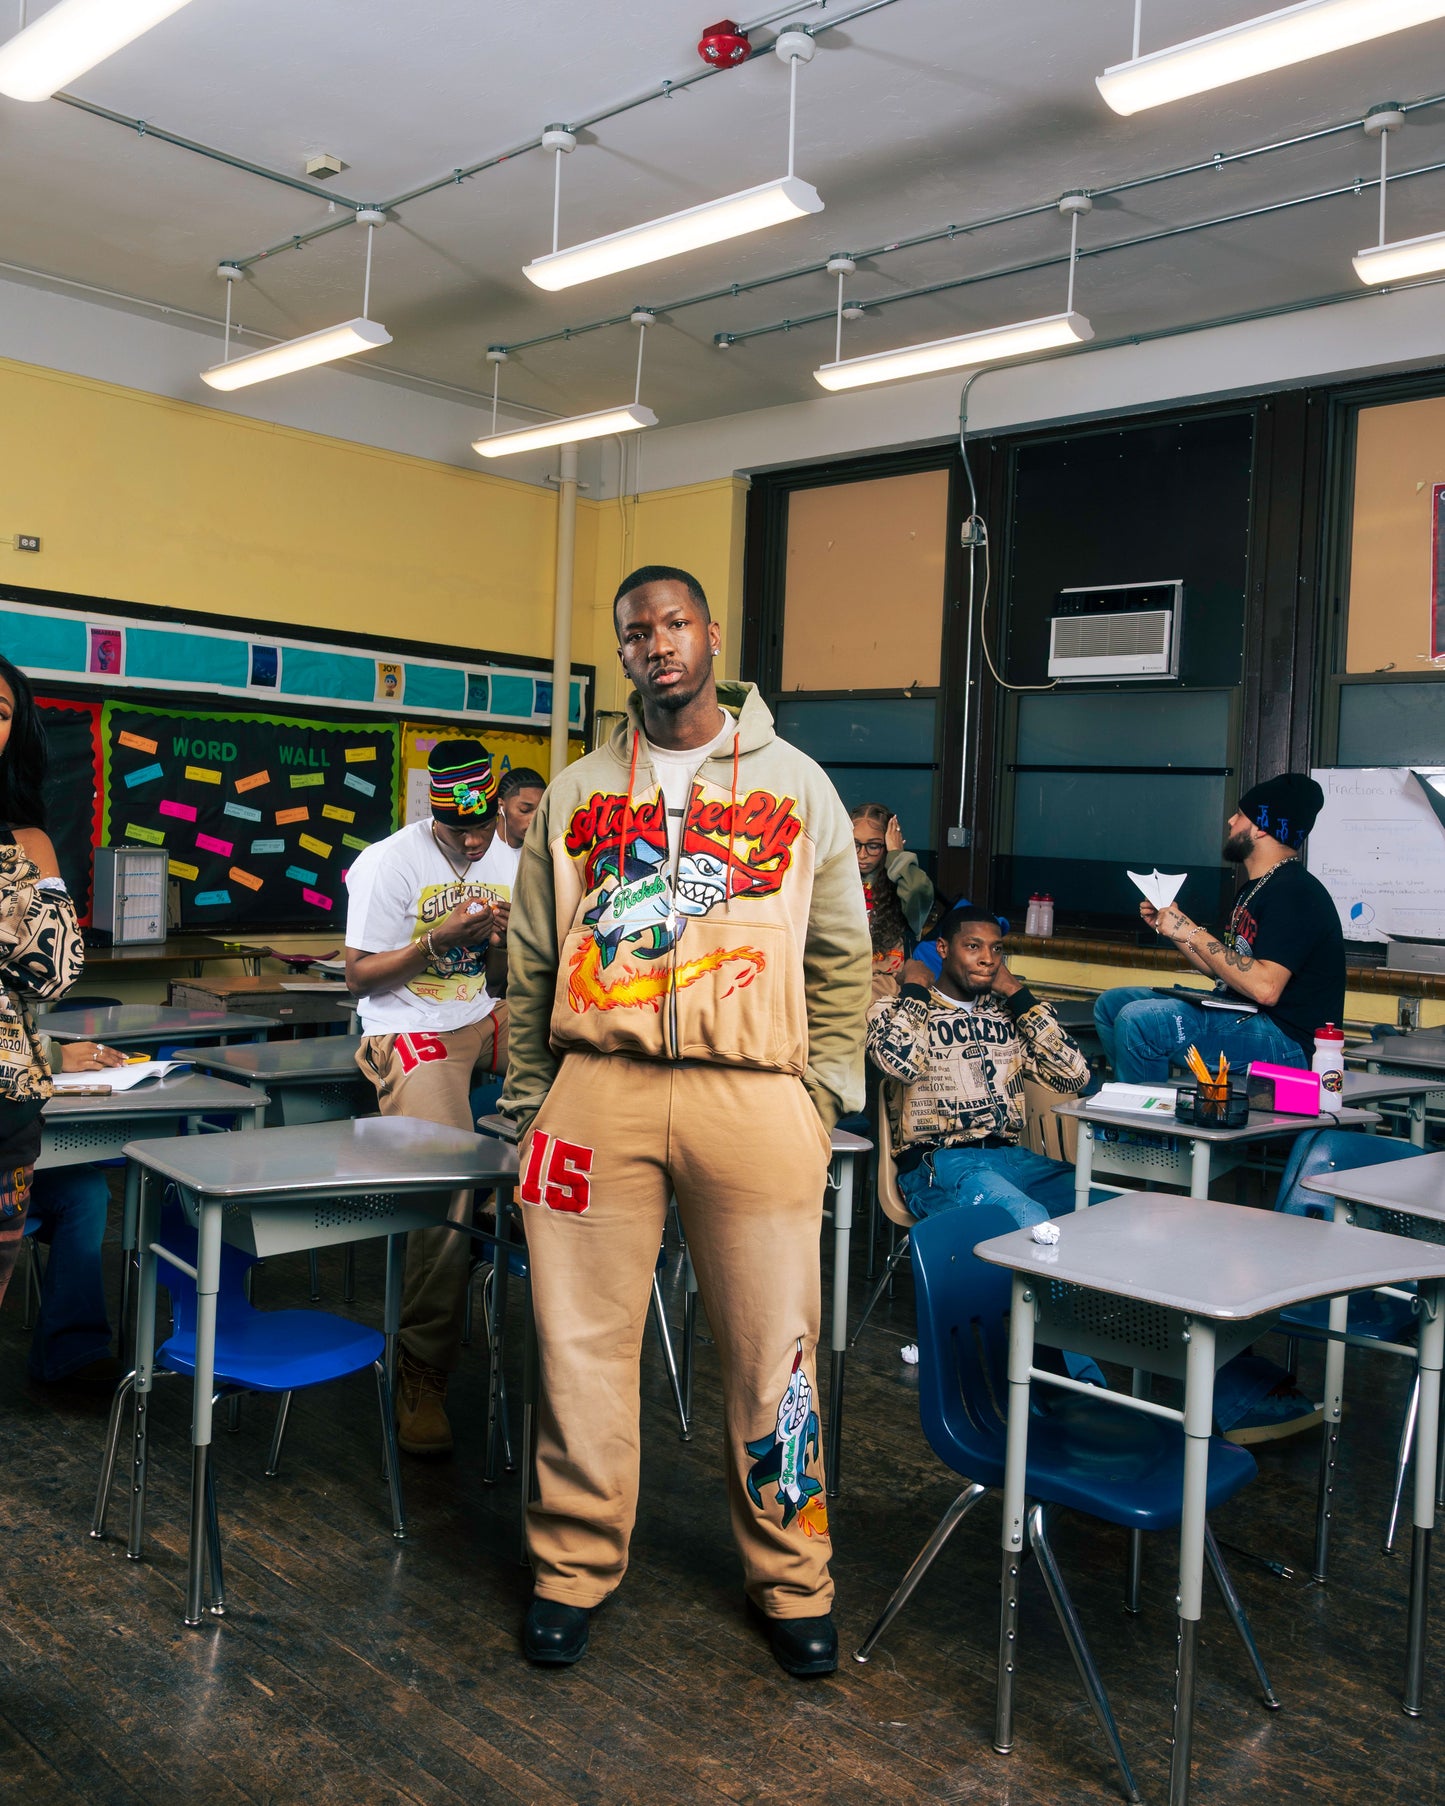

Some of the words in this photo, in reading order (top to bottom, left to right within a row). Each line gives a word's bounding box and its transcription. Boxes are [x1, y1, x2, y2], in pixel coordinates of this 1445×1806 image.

[382, 664, 398, 673] JOY
[173, 736, 238, 762] WORD
[279, 745, 330, 767] WALL
[1327, 774, 1384, 797] Fractions
[422, 885, 506, 923] STOCKED
[613, 875, 667, 919] Rockets
[8, 1028, 19, 1038] LIFE
[928, 1016, 1017, 1048] TOCKEDU
[393, 1032, 449, 1077] 15
[910, 1099, 933, 1108] TRAVELS
[910, 1108, 937, 1117] OVERSEAS
[520, 1128, 595, 1215] 15
